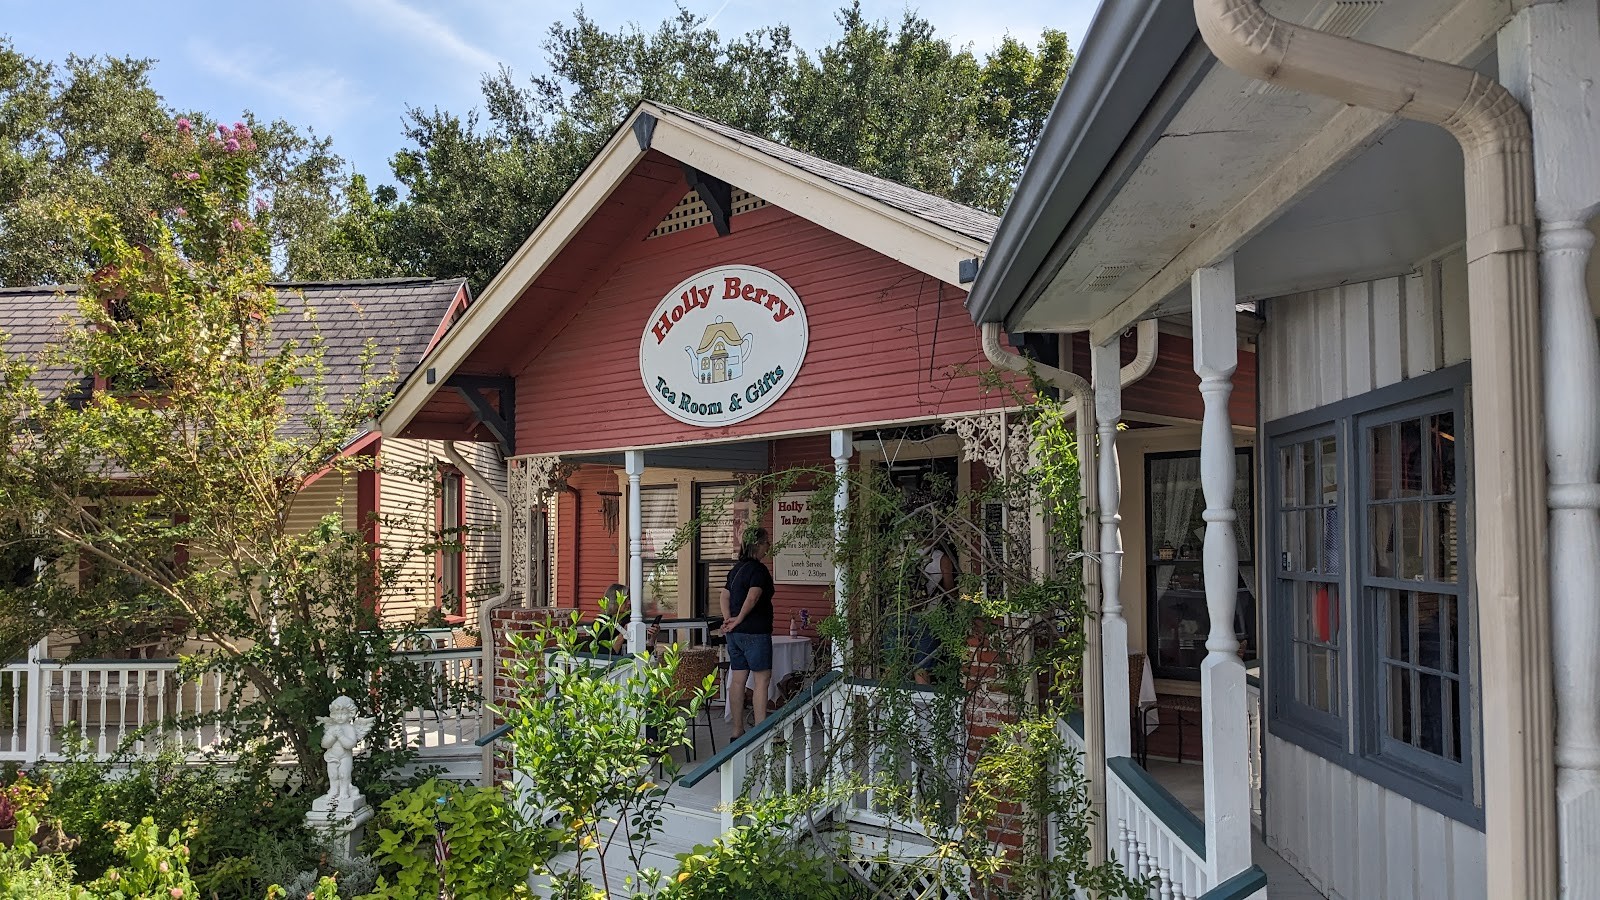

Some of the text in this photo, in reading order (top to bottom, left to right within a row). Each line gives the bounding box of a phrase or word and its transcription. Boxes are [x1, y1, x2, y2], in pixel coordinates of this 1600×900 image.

[651, 277, 795, 345] Holly Berry
[655, 364, 785, 416] Tea Room & Gifts
[778, 501, 804, 512] Holly
[781, 515, 791, 525] Tea
[791, 560, 823, 568] Lunch Served
